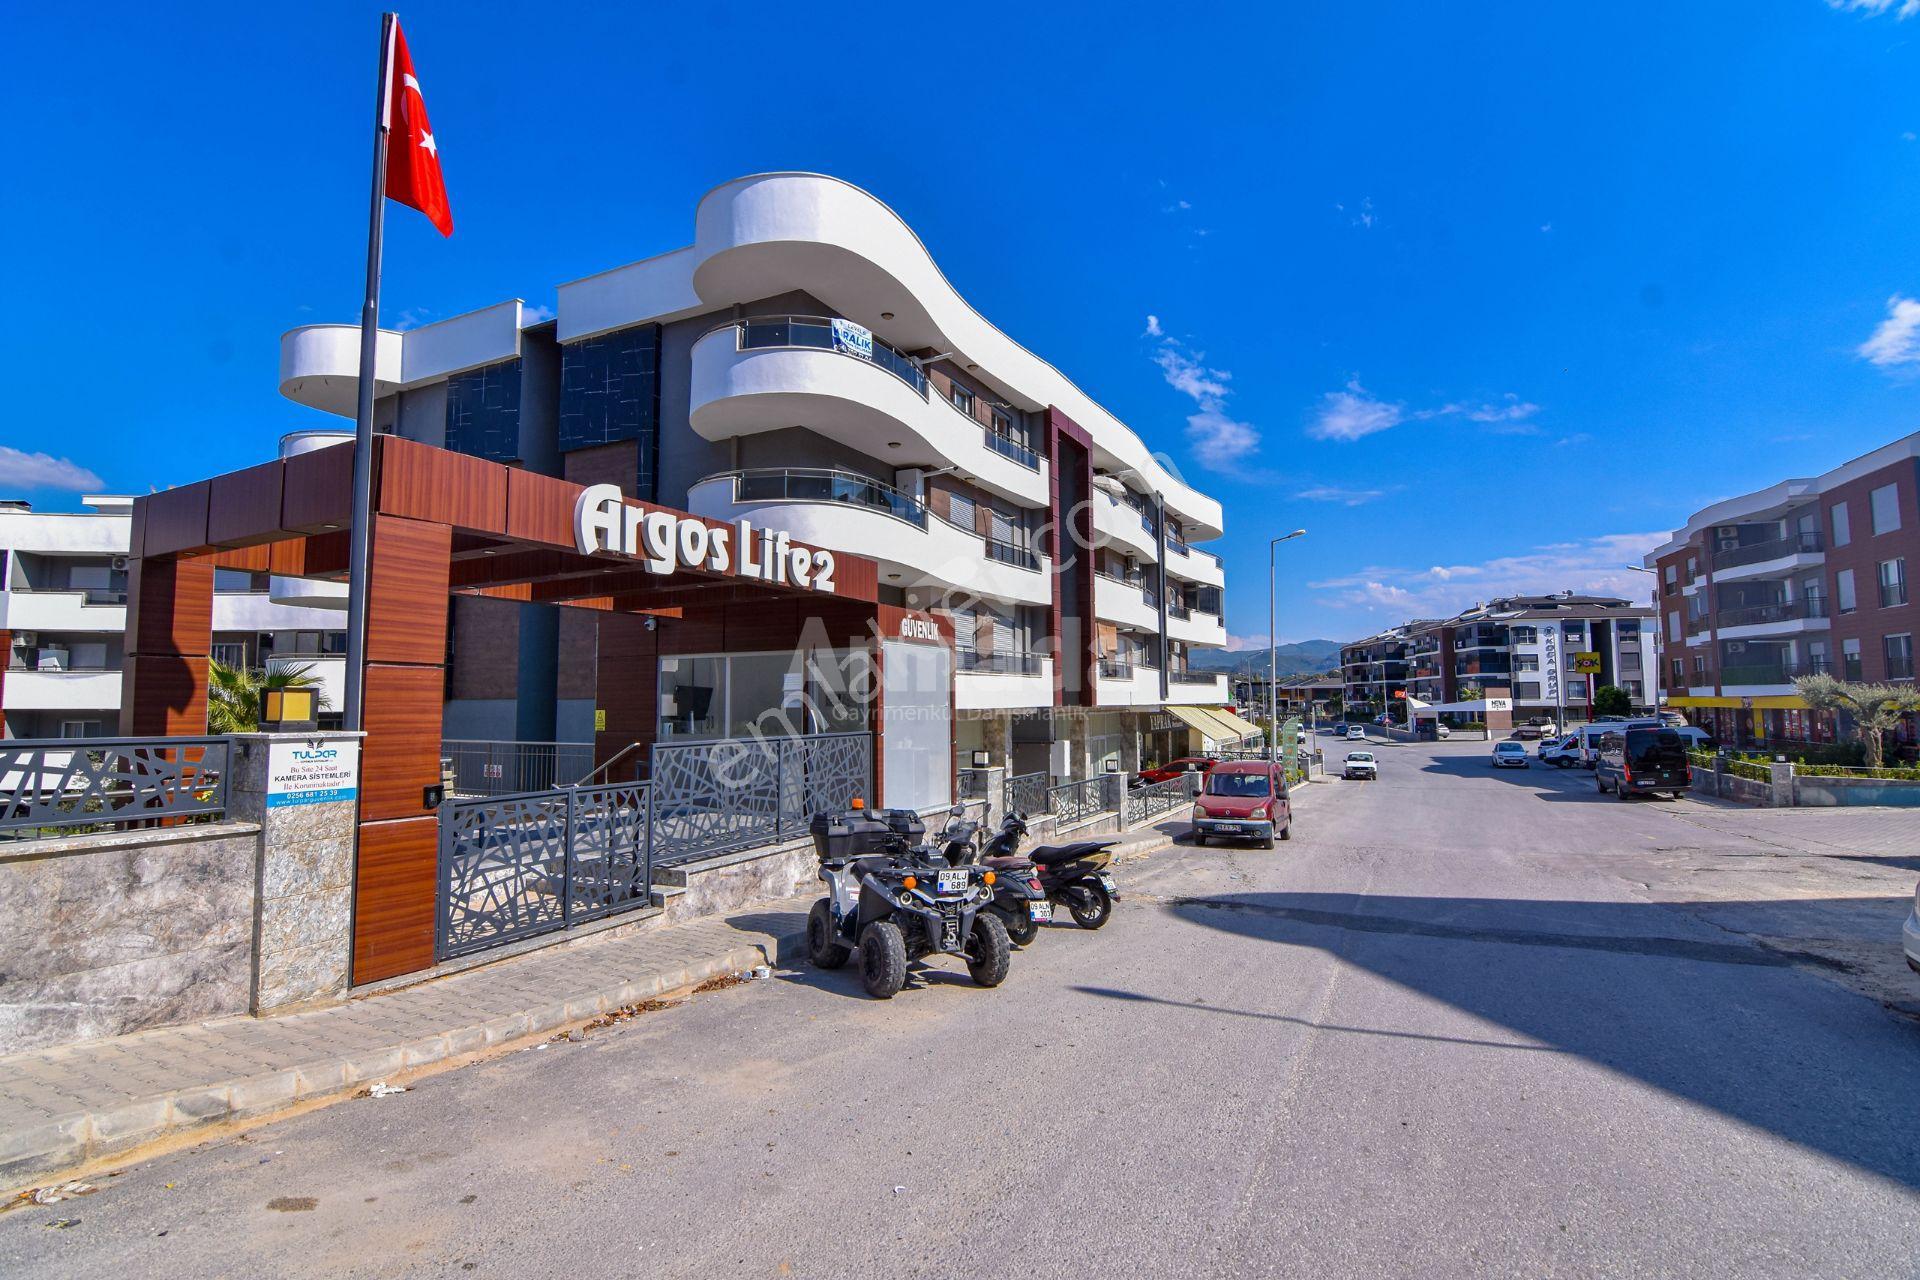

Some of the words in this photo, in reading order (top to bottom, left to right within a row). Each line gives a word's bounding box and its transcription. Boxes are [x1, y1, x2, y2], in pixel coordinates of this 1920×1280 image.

[574, 483, 730, 575] Argos
[901, 614, 939, 641] GÜVENLİK
[274, 773, 308, 782] KAMERA
[309, 770, 351, 780] SİSTEMLERİ
[940, 872, 950, 881] 09
[952, 871, 968, 880] ALJ
[951, 881, 966, 890] 689
[1030, 902, 1039, 910] 09
